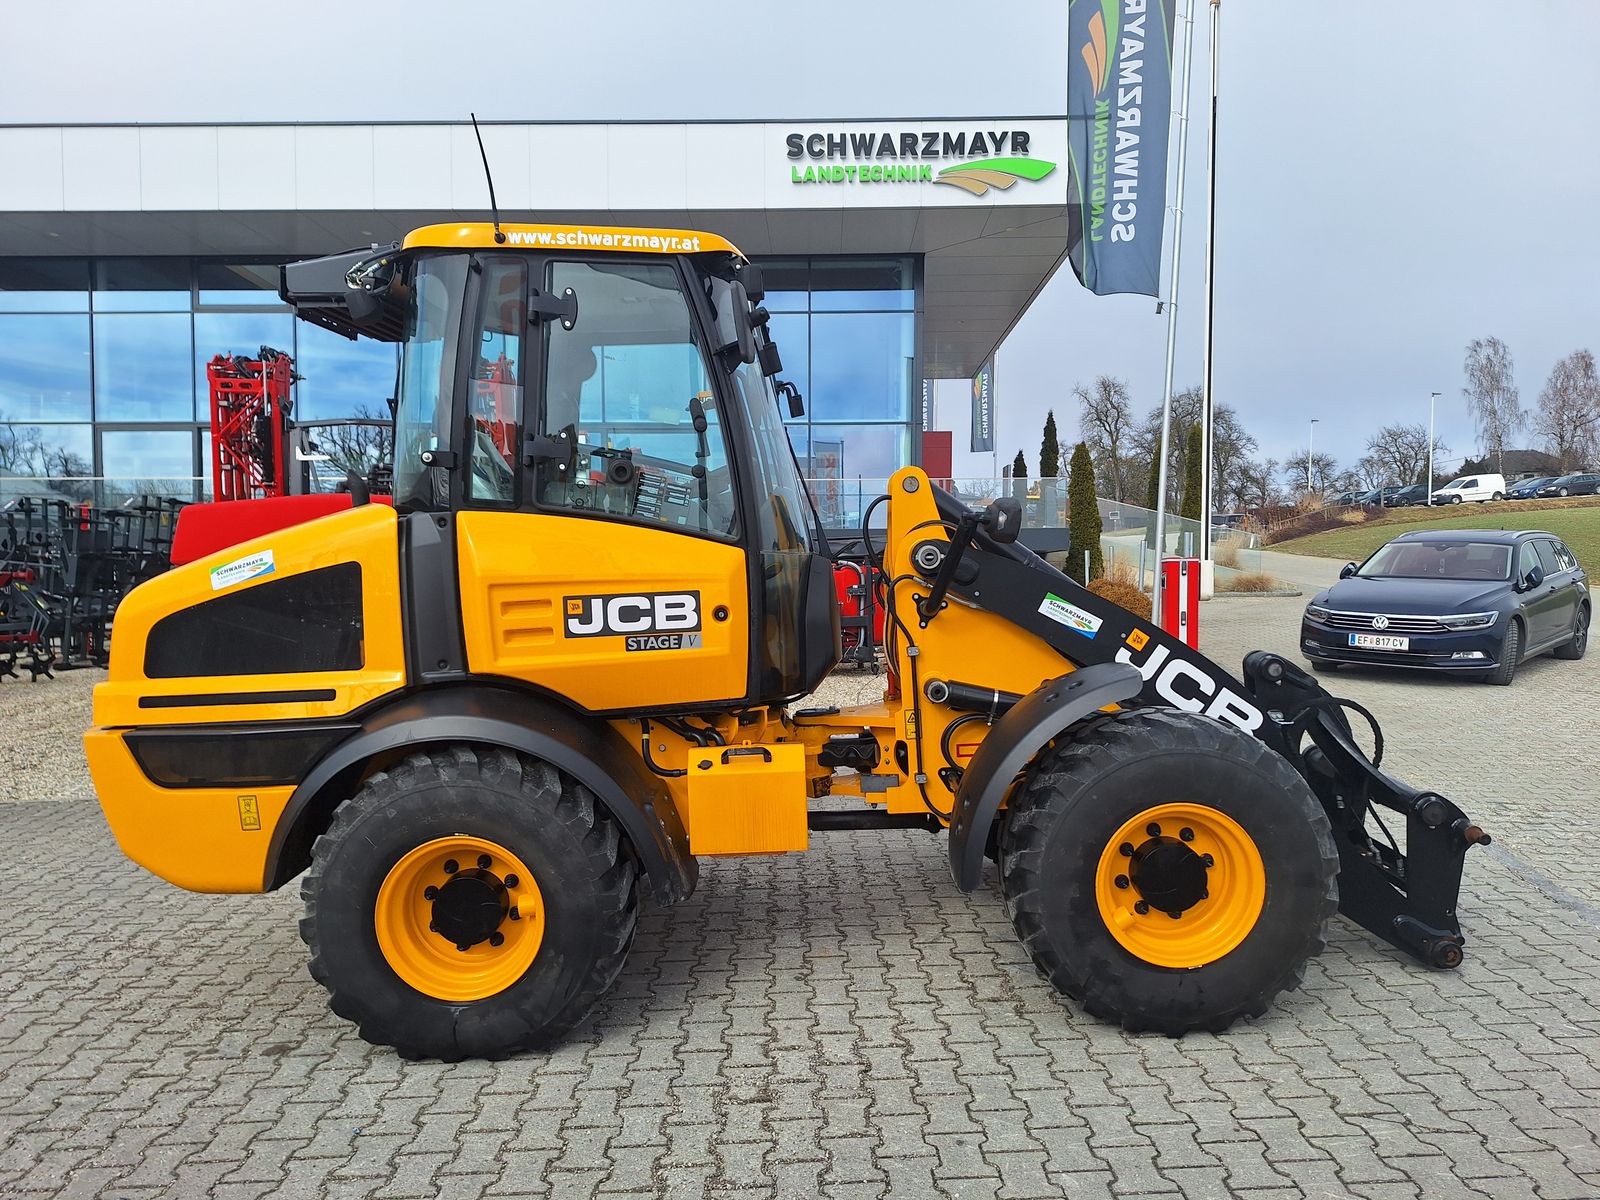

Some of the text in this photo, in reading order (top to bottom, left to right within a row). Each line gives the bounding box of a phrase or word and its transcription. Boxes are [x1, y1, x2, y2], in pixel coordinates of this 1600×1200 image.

[786, 131, 1031, 160] SCHWARZMAYR
[791, 165, 933, 184] LANDTECHNIK
[507, 230, 700, 251] www.schwarzmayr.at
[216, 557, 264, 577] SCHWARZMAYR
[567, 594, 699, 635] JCB
[1049, 600, 1092, 625] SCHWARZMAYR
[627, 634, 698, 650] STAGE V
[1357, 635, 1404, 648] EF 817 CV
